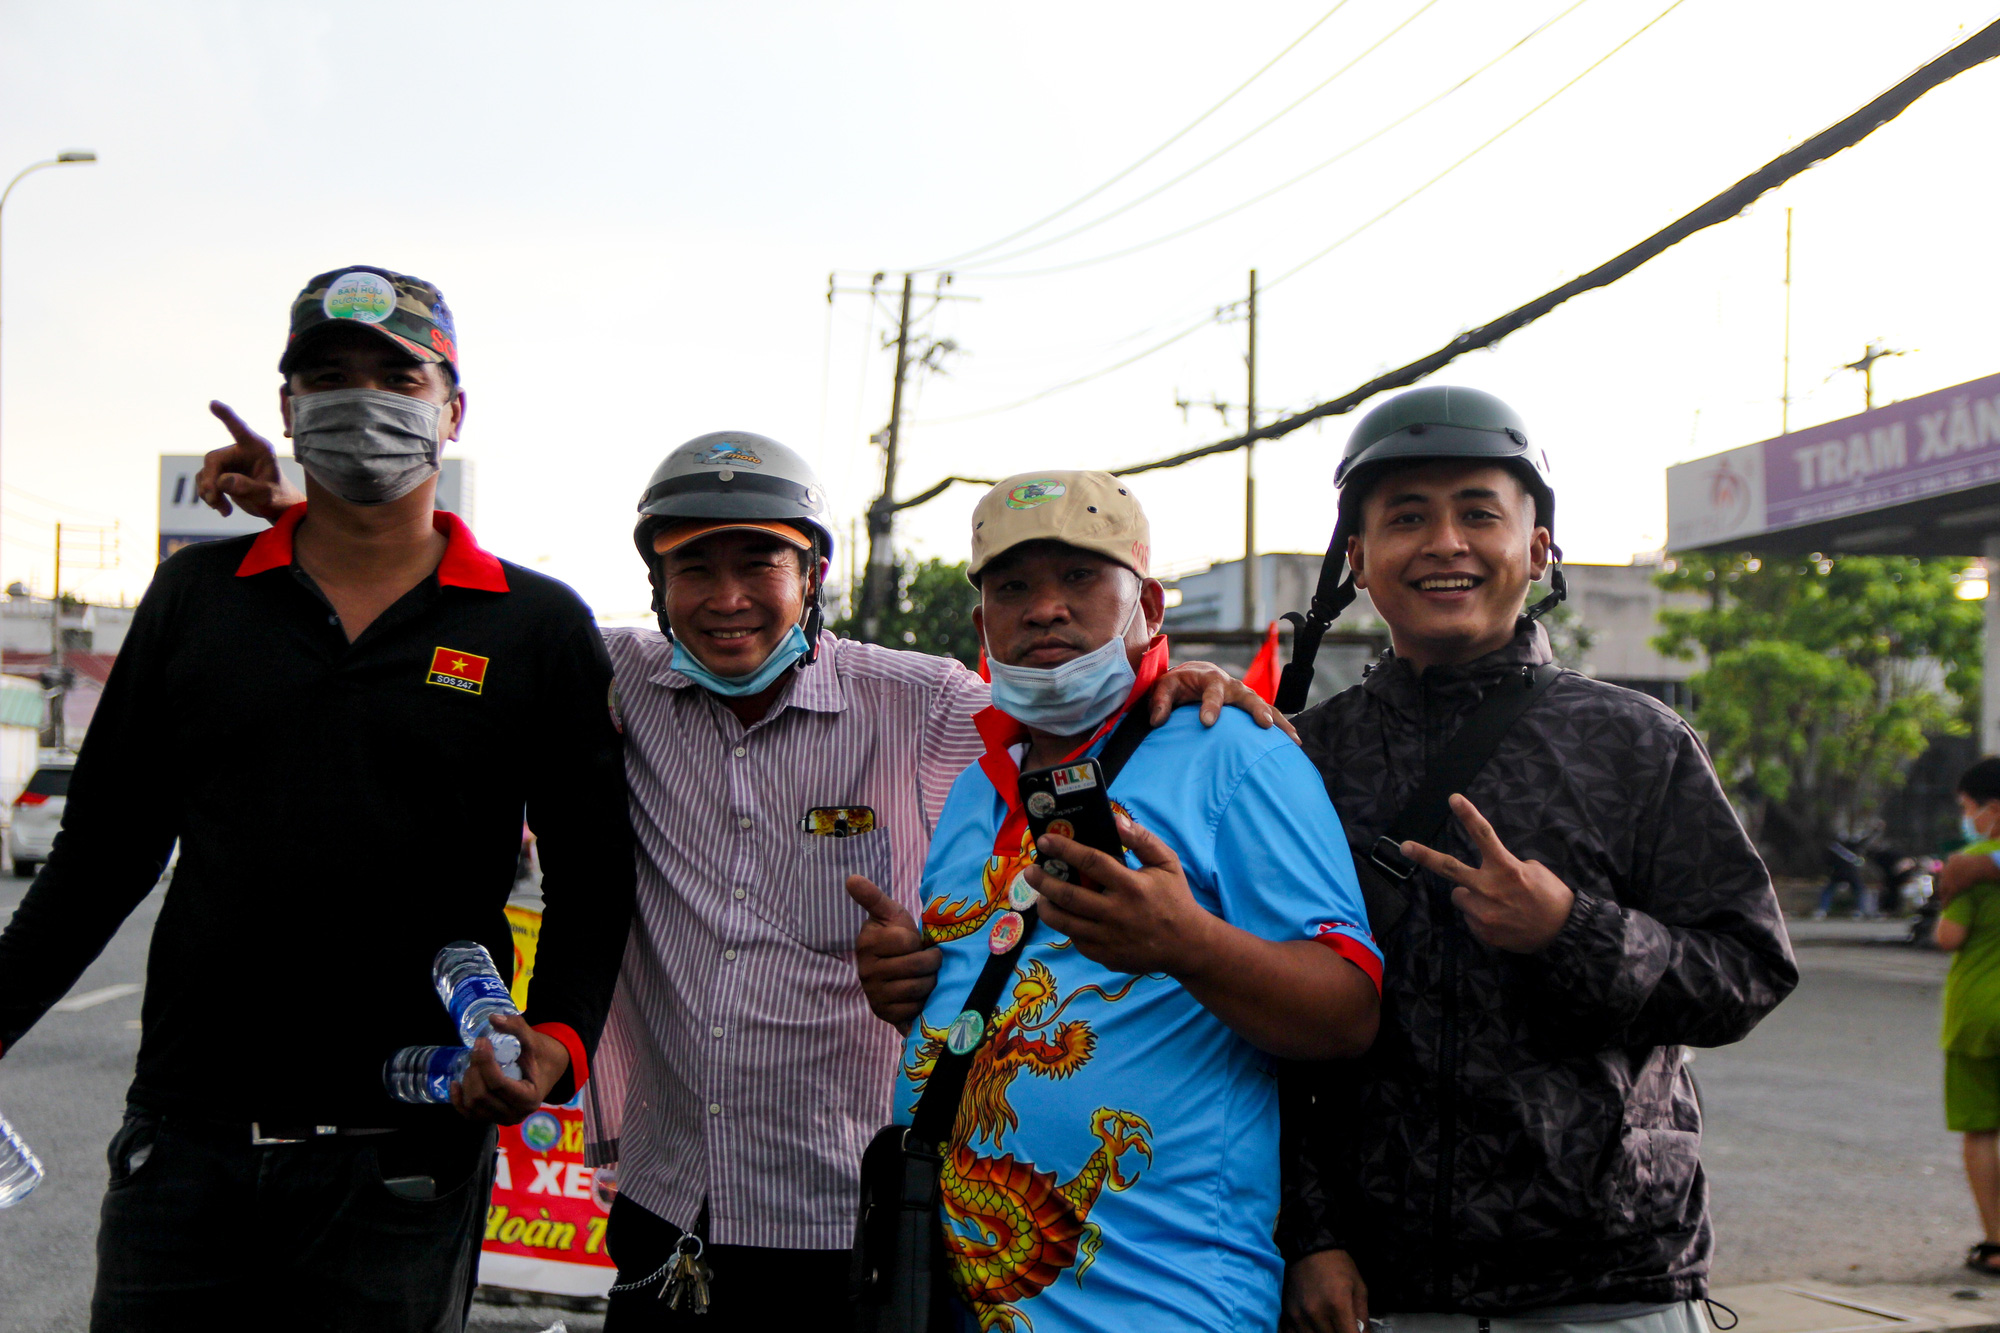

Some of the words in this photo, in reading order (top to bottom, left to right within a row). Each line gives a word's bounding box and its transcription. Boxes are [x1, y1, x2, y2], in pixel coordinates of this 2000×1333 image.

[1793, 422, 1907, 490] TRẠM
[437, 675, 456, 686] SOS
[456, 680, 474, 689] 247
[1053, 765, 1090, 787] HLX
[527, 1158, 595, 1200] XE
[585, 1216, 610, 1256] T
